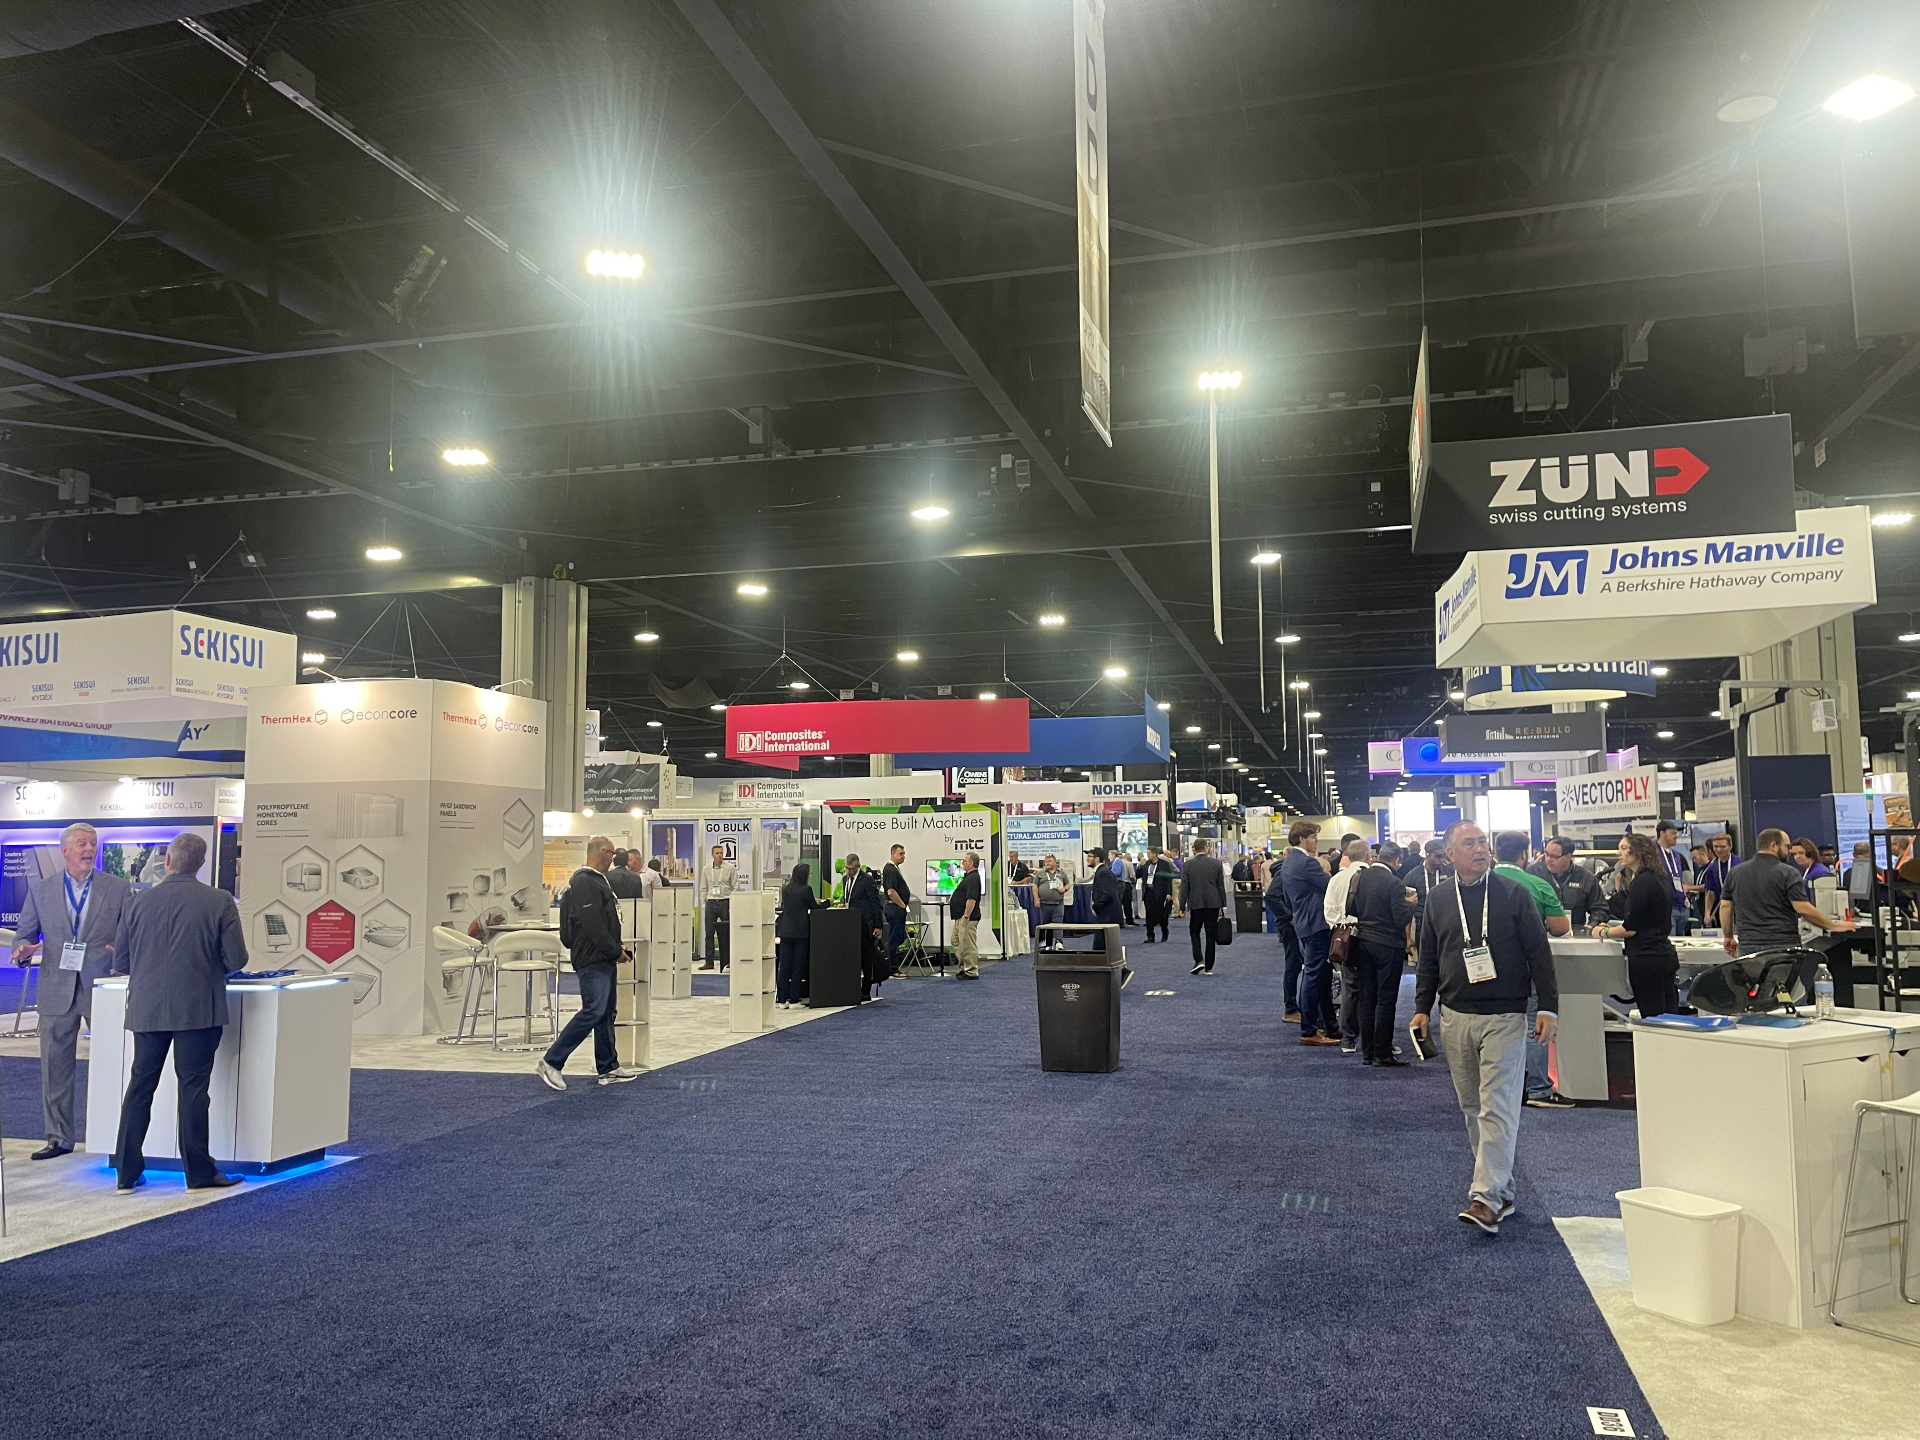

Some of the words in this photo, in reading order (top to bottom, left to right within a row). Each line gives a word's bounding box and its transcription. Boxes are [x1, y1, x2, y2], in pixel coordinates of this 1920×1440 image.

[1489, 508, 1537, 524] swiss
[1543, 504, 1605, 521] cutting
[1611, 500, 1687, 519] systems
[1602, 546, 1698, 575] Johns
[1704, 533, 1844, 565] Manville
[1600, 581, 1612, 593] A
[1616, 577, 1685, 593] Berkshire
[1689, 573, 1766, 591] Hathaway
[1771, 568, 1844, 586] Company
[180, 624, 263, 669] SEKISUI
[74, 680, 95, 690] SEKISUI
[127, 676, 149, 685] SEKISUI
[32, 683, 53, 692] SEKISUI
[261, 714, 312, 725] ThermHex
[356, 708, 417, 720] econcore
[442, 712, 477, 725] ThermHex
[503, 721, 538, 734] econcore
[1515, 726, 1571, 735] RE:BUILD
[764, 729, 823, 742] Composites
[764, 740, 830, 752] International
[757, 781, 799, 791] Composites
[1092, 784, 1162, 795] NORPLEX
[1574, 776, 1650, 806] VECTORPLY
[757, 790, 804, 798] International
[706, 823, 720, 832] GO
[723, 823, 750, 832] BULK
[838, 816, 886, 833] Purpose
[891, 816, 918, 830] Built
[922, 815, 984, 829] Machines
[944, 834, 954, 844] by
[954, 838, 984, 850] mtc
